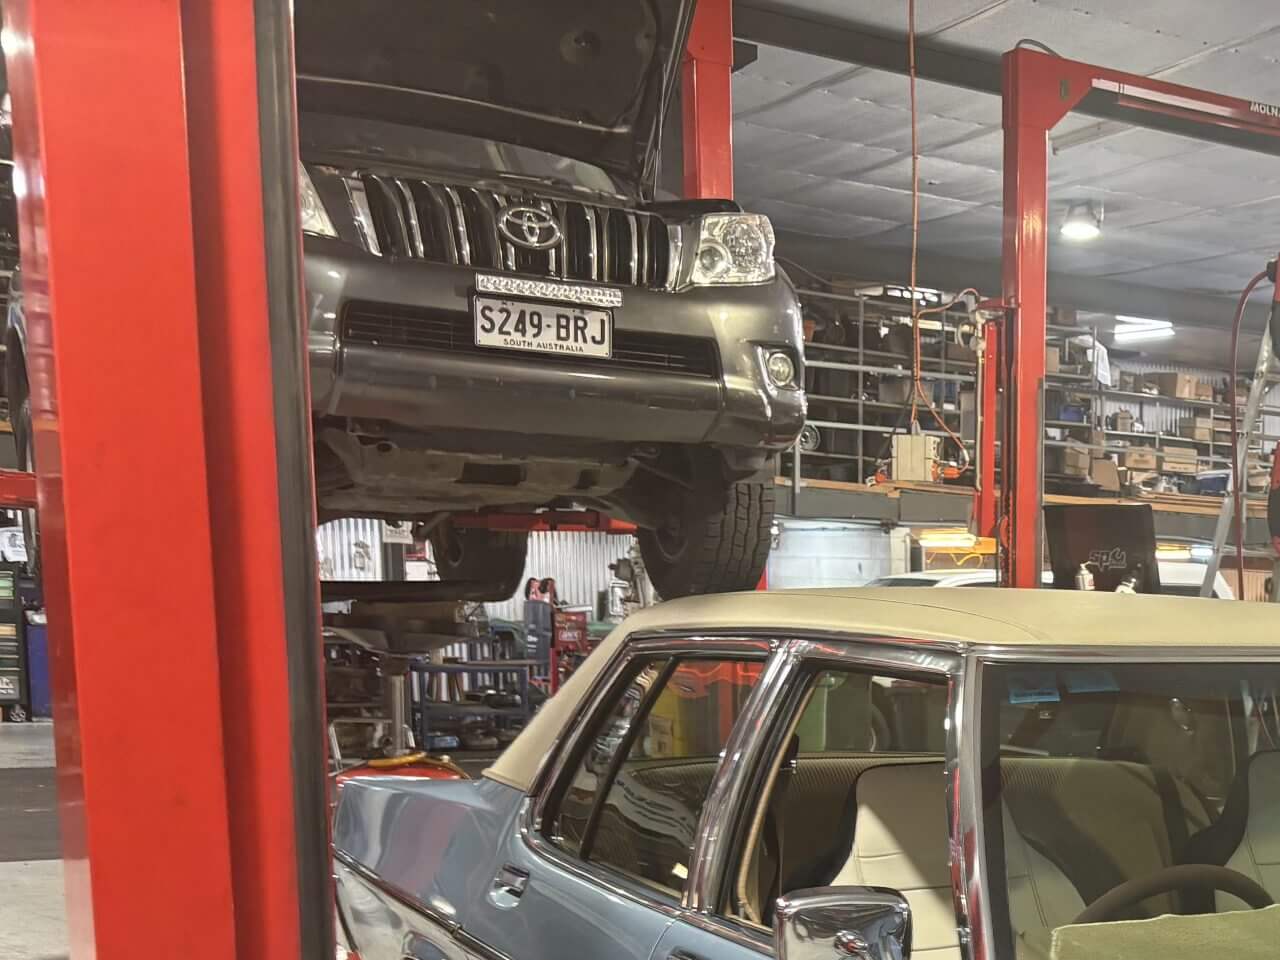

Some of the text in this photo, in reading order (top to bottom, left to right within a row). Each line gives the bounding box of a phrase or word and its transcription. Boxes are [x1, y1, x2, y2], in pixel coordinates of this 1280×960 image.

[480, 305, 606, 345] S249-BRJ
[503, 338, 584, 353] SOUTH AUSTRALIA
